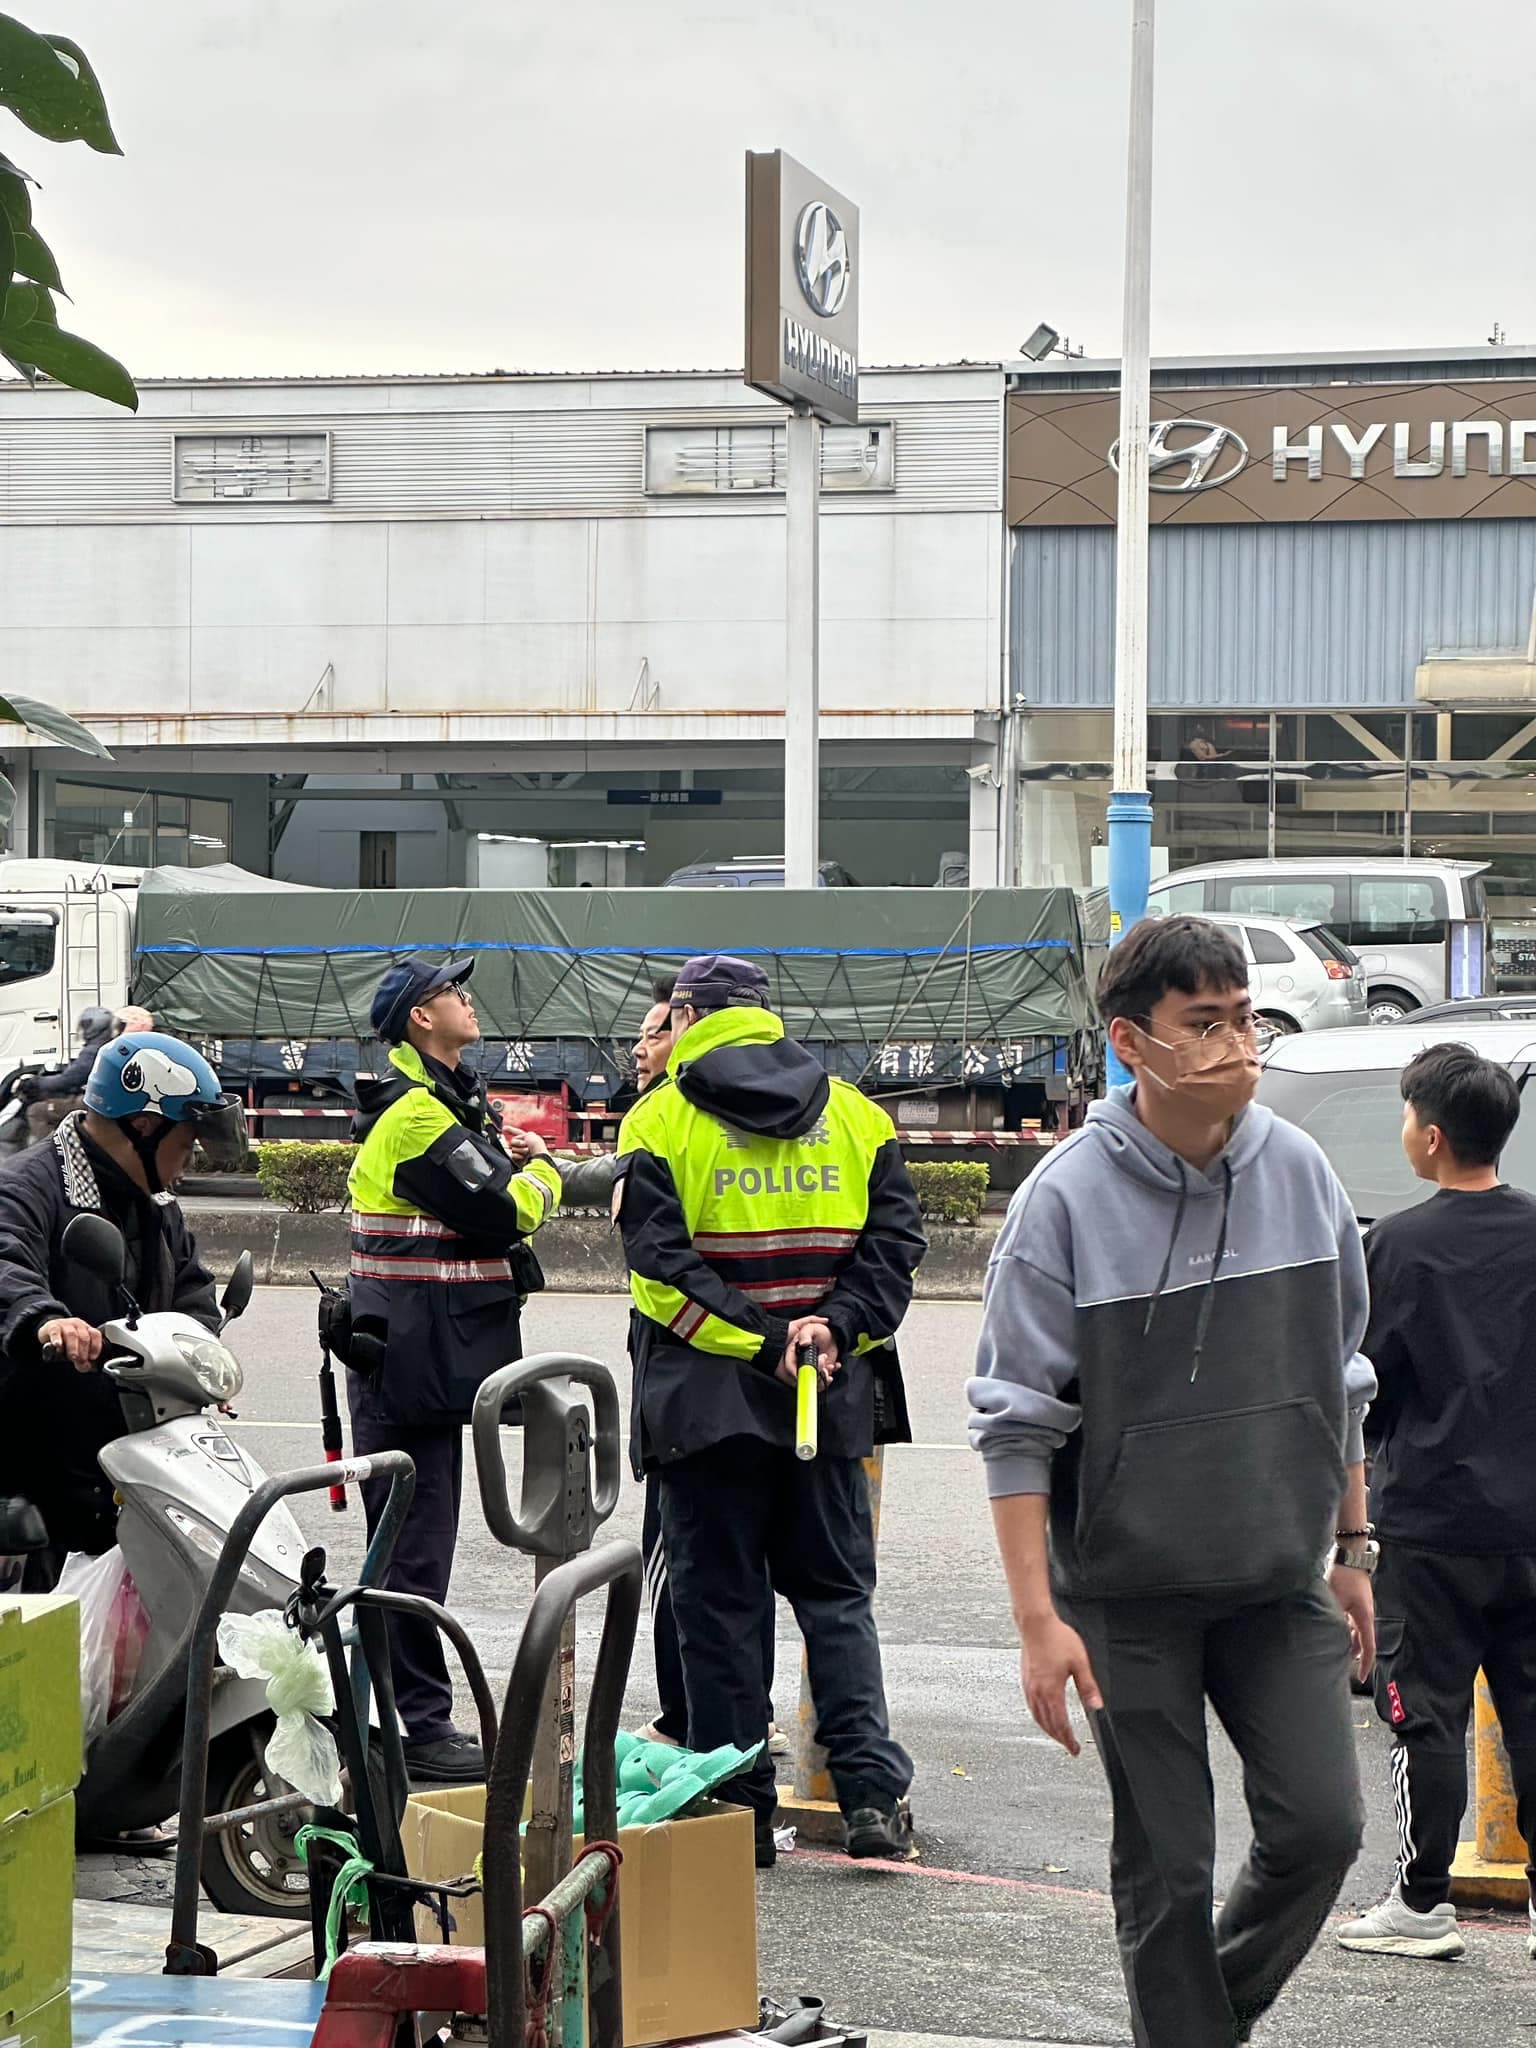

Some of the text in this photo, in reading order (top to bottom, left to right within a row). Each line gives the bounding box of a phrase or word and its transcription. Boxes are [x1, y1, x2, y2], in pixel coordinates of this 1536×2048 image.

[784, 317, 857, 400] HYUNDAI
[714, 1165, 841, 1197] POLICE
[1188, 1248, 1241, 1267] KANOL
